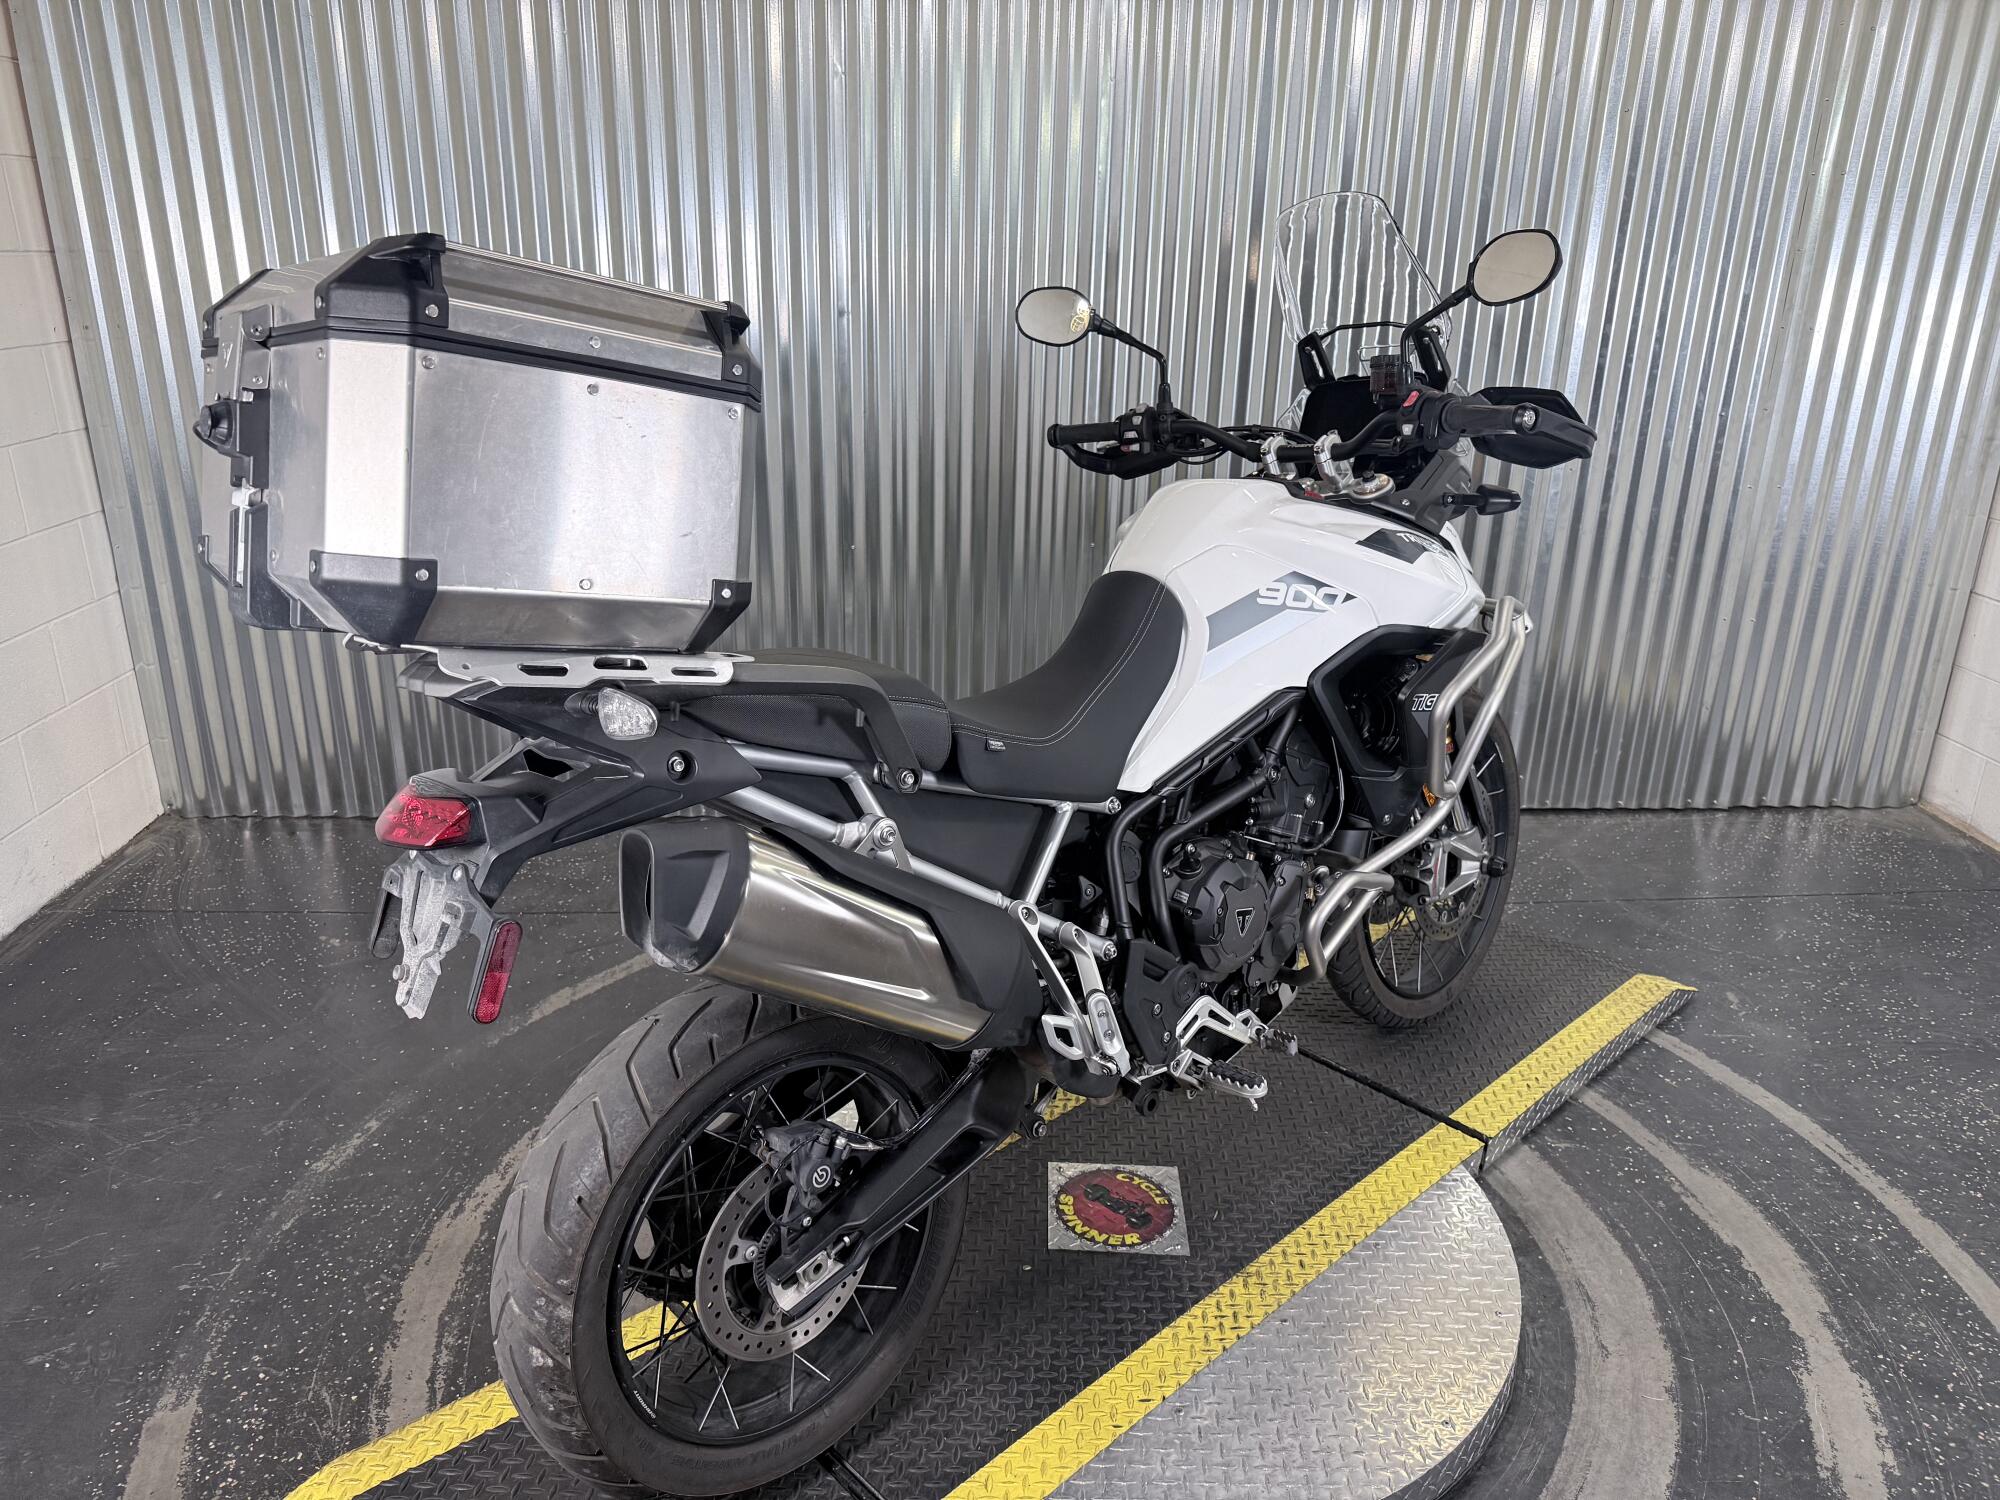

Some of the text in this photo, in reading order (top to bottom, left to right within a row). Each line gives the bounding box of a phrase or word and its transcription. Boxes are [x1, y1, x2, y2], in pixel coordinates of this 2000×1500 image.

[1257, 581, 1347, 611] 900
[1411, 693, 1440, 711] TIG
[1115, 1173, 1168, 1205] CYCLE
[1058, 1193, 1142, 1245] SPINNER
